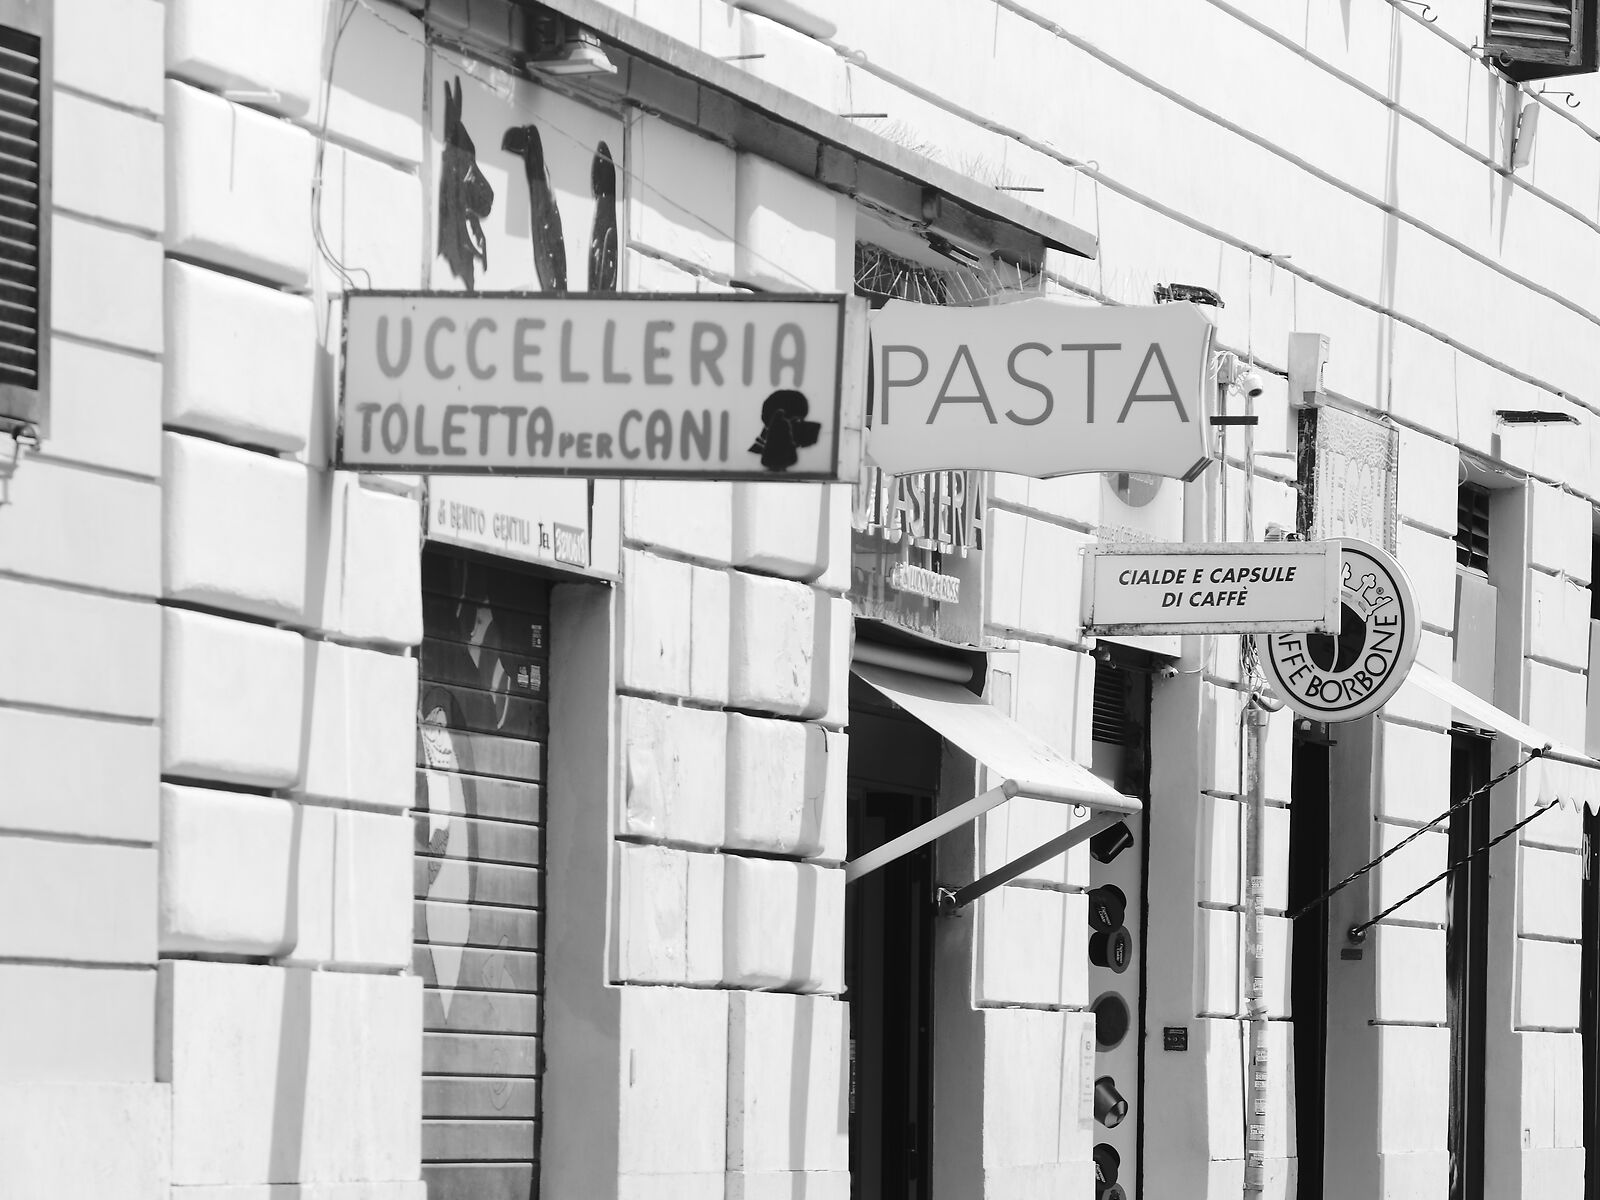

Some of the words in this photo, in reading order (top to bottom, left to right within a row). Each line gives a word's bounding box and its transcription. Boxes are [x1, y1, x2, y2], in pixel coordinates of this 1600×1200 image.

[376, 315, 808, 388] UCCELLERIA
[881, 341, 1191, 426] PASTA
[356, 402, 554, 458] TOLETTA
[558, 431, 614, 460] PER
[618, 408, 731, 463] CANI
[1118, 568, 1189, 586] CIALDE
[1192, 567, 1206, 585] E
[1208, 565, 1298, 584] CAPSULE
[1161, 592, 1186, 609] DI
[1188, 586, 1249, 608] CAFFÈ
[1304, 614, 1399, 703] BORBONE
